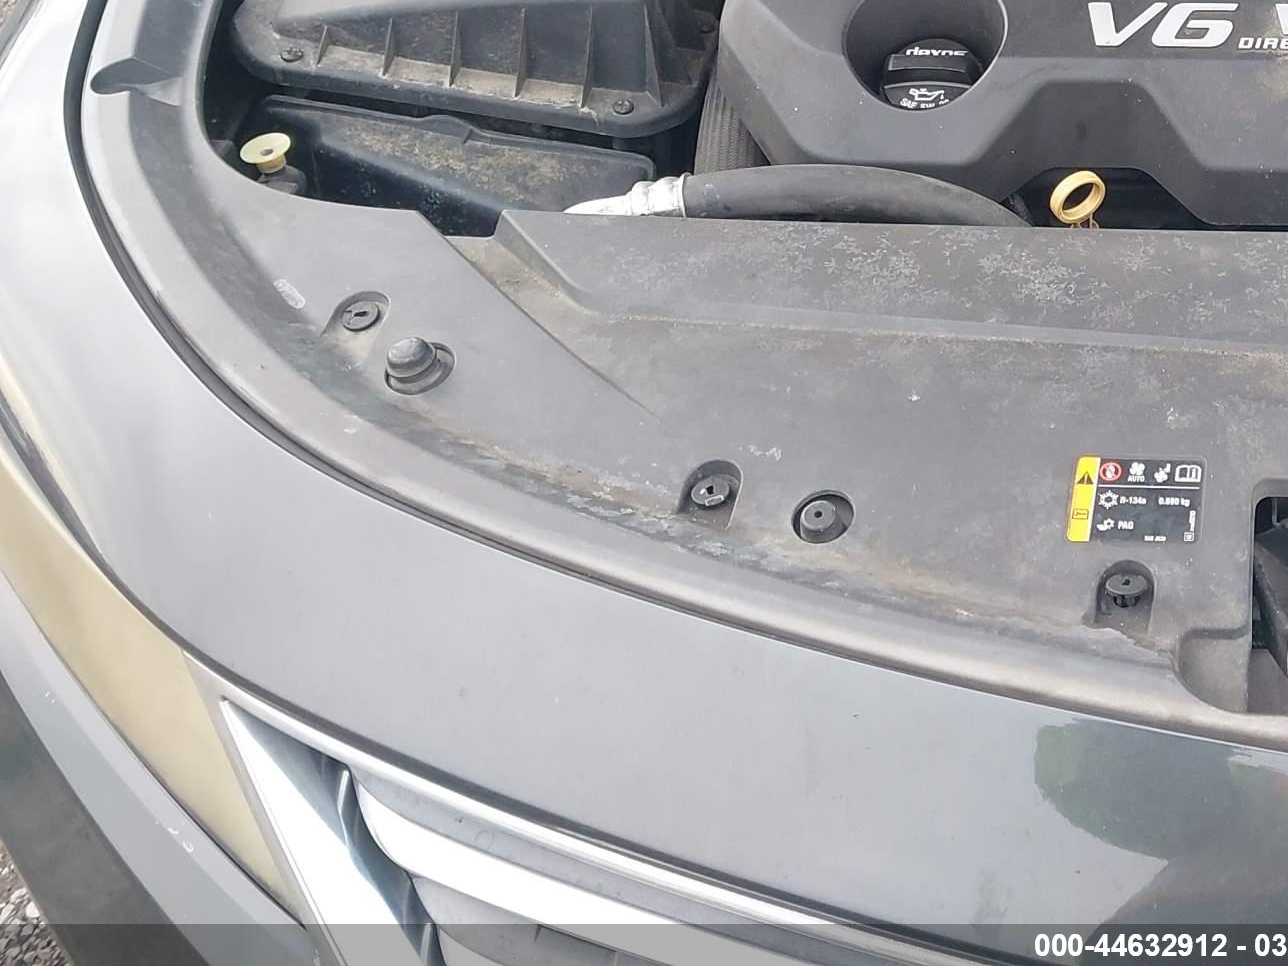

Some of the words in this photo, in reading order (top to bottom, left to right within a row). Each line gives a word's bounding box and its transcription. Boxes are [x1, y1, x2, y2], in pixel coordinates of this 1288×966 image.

[1087, 1, 1240, 47] V6
[1127, 474, 1146, 482] AUTO
[1181, 497, 1191, 508] kg
[1117, 520, 1134, 530] PAG
